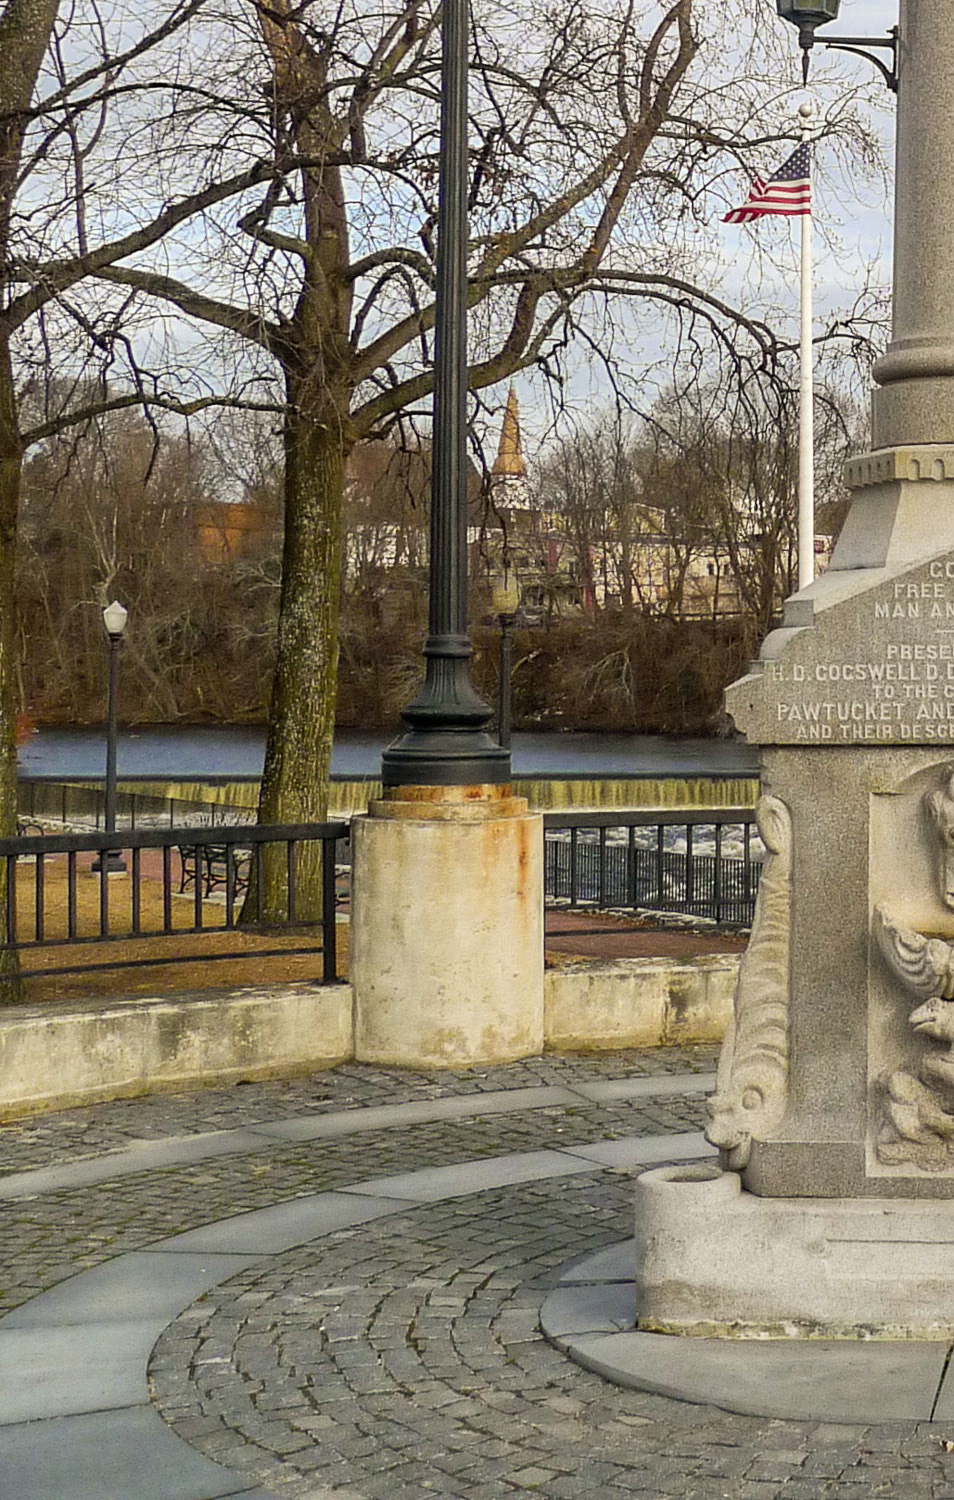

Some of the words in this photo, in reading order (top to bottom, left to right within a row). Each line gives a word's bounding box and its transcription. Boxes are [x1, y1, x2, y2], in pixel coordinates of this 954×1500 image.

[894, 582, 946, 599] FREE
[873, 601, 920, 619] MAN
[815, 662, 921, 681] COGSWELL
[872, 684, 896, 699] TO
[902, 683, 938, 699] THE
[776, 701, 907, 721] PAWTUCKET
[796, 723, 833, 740] AND
[840, 723, 894, 740] THEIR
